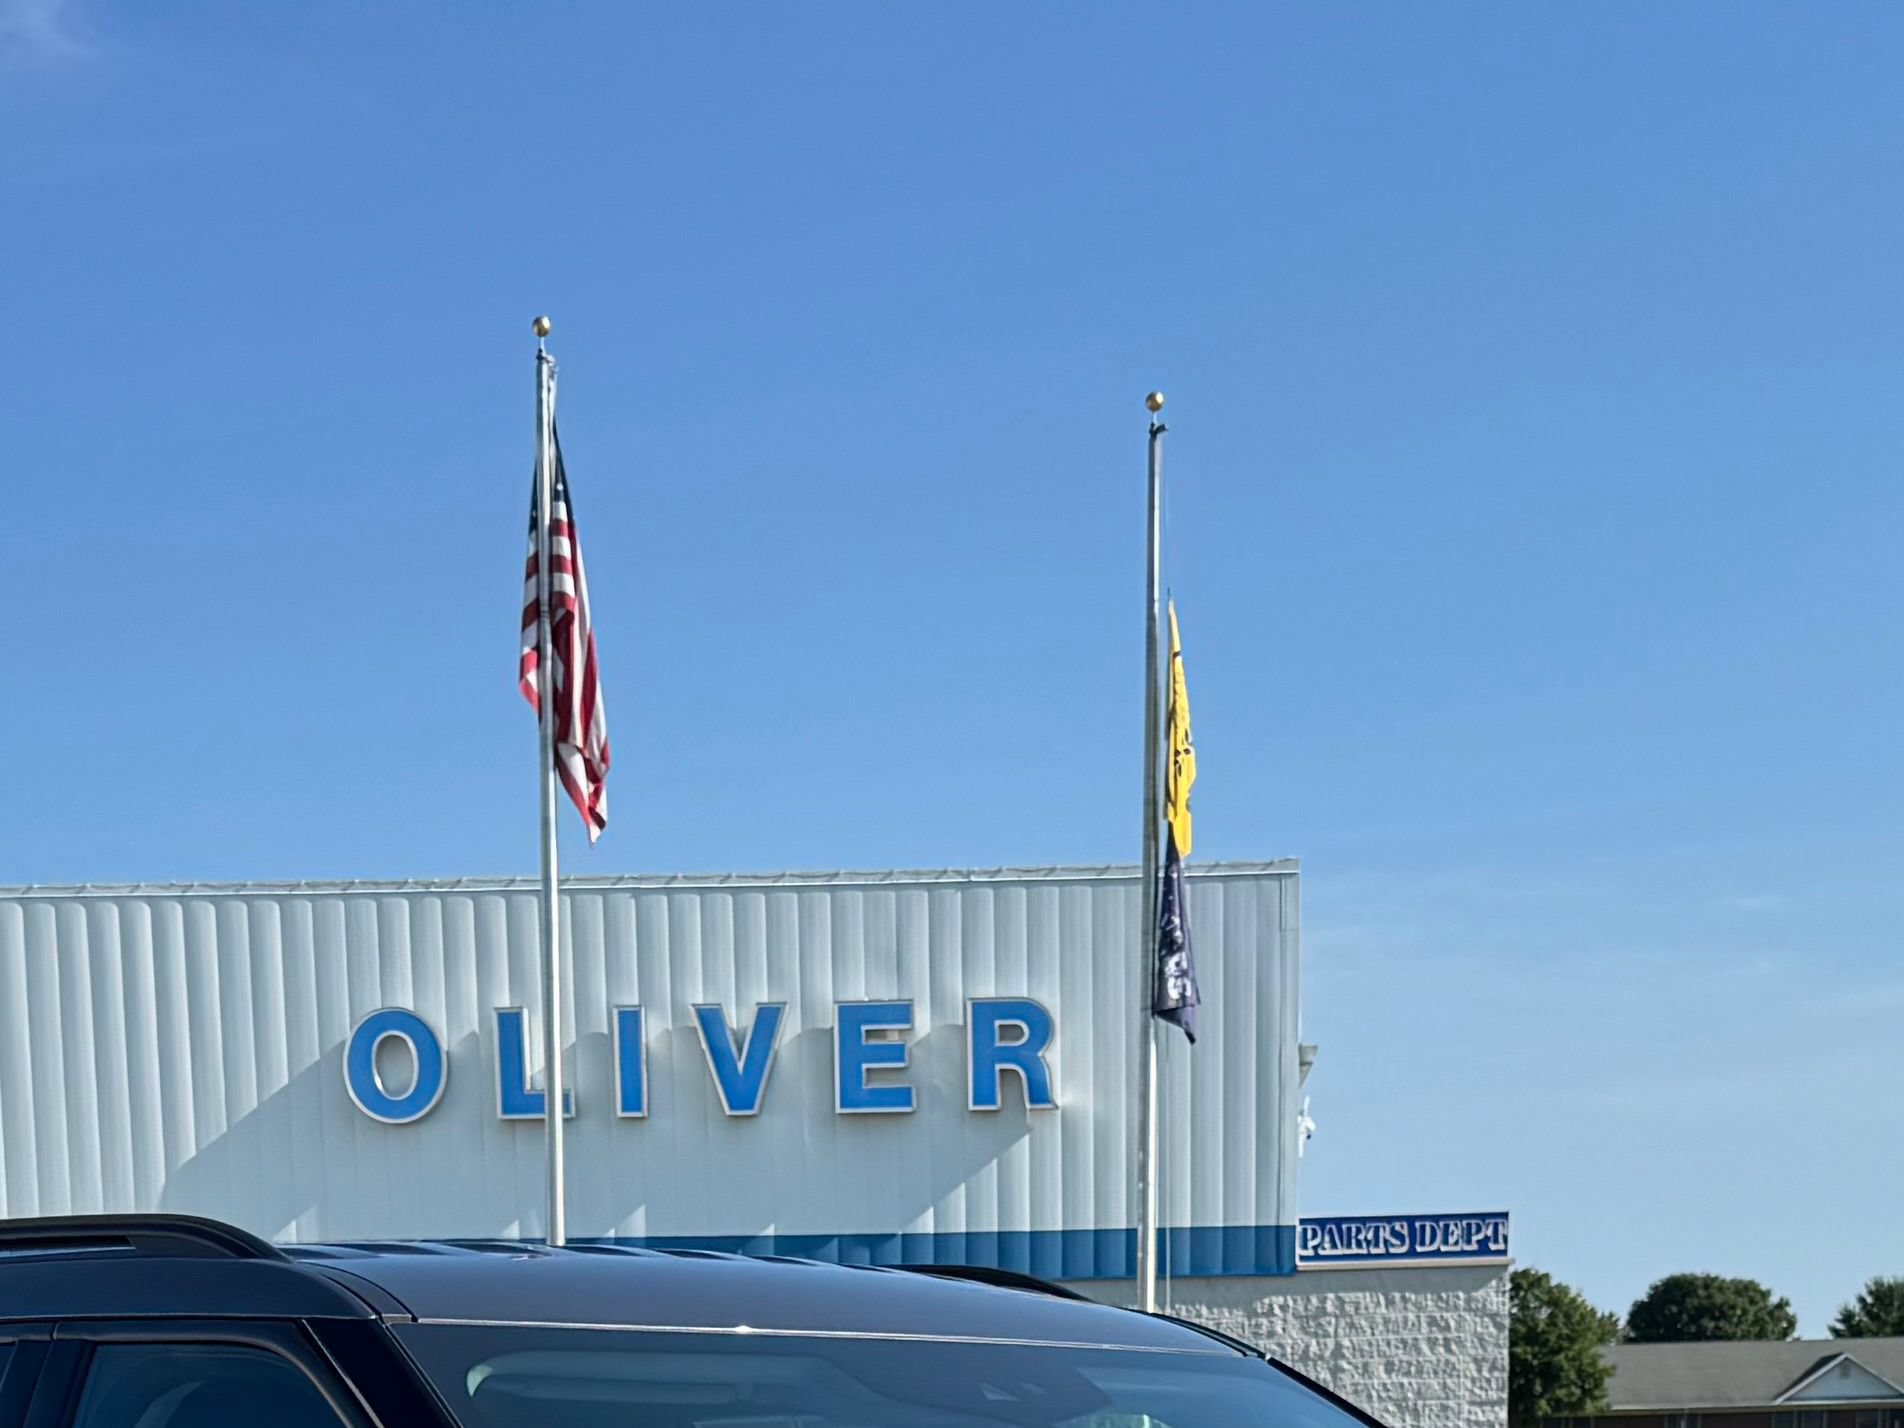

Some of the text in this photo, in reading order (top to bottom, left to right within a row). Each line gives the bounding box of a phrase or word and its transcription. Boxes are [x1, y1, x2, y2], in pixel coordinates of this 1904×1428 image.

[342, 996, 1060, 1125] OLIVER
[1298, 1218, 1507, 1257] PARTS DEPT
